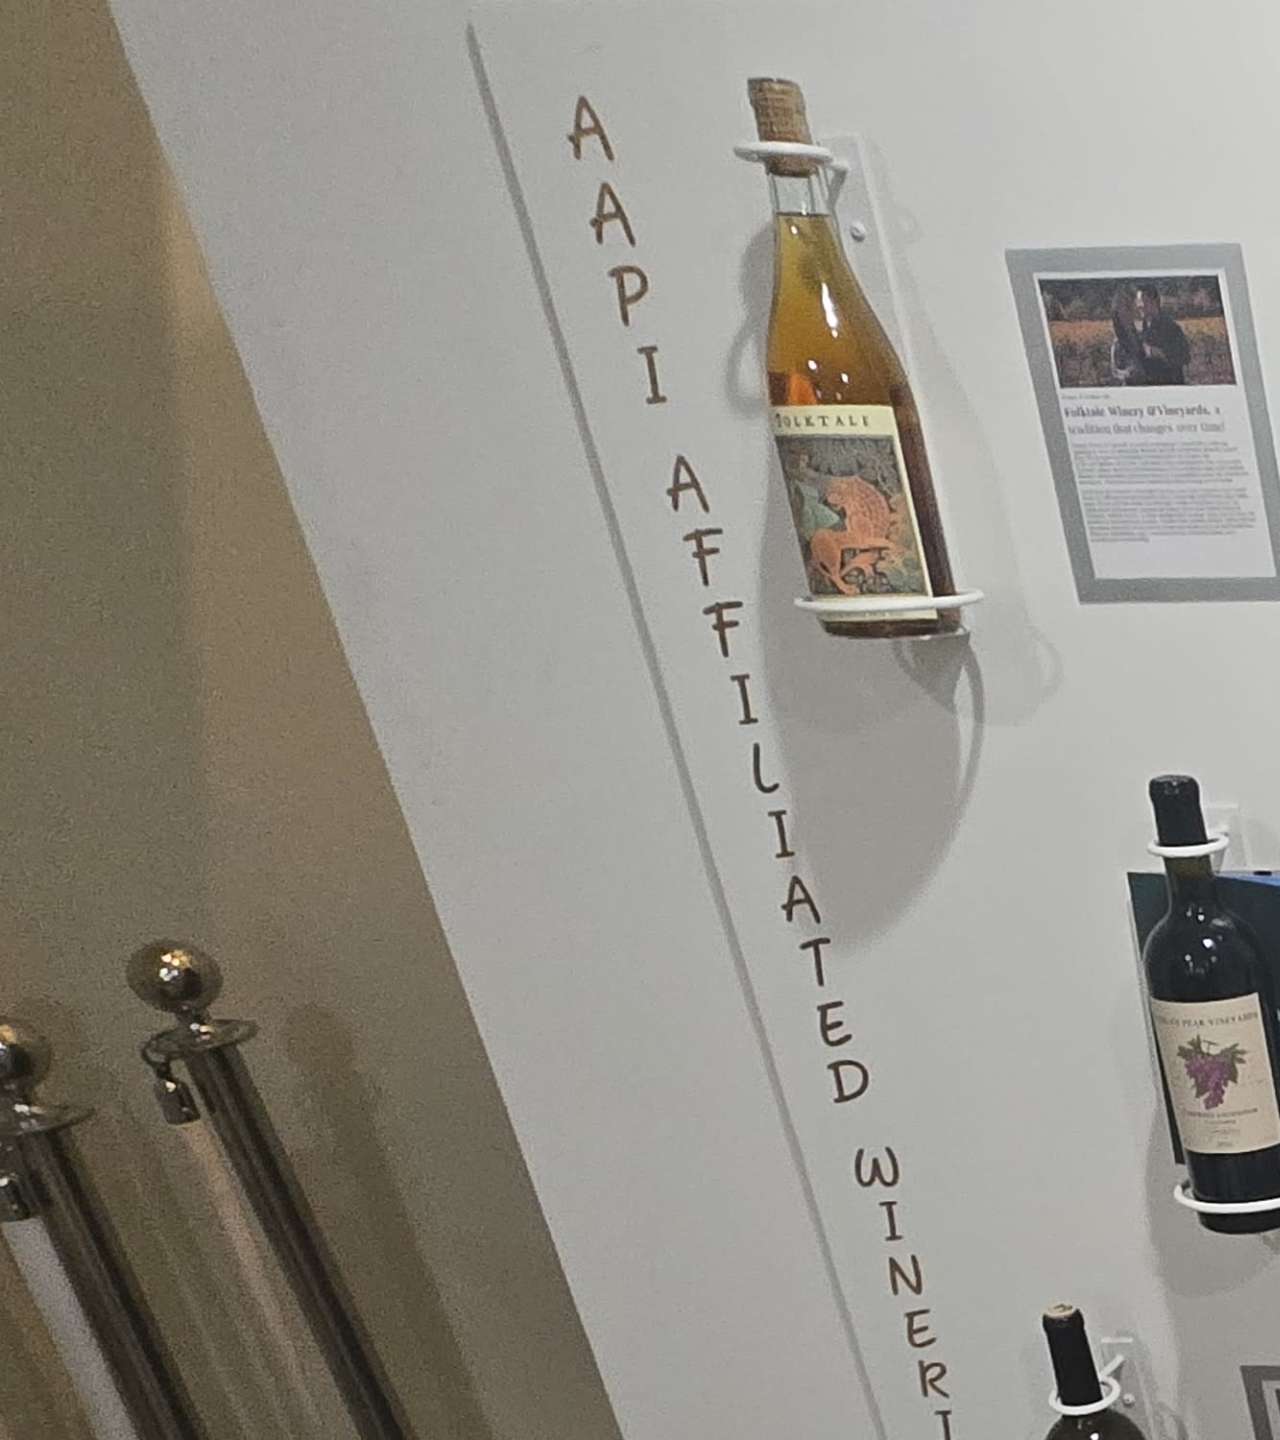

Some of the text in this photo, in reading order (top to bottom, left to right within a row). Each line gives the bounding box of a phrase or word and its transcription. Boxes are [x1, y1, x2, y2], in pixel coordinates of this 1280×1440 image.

[568, 95, 668, 404] AAPI
[666, 455, 871, 1104] AFFILIATED
[1109, 406, 1144, 419] Winery
